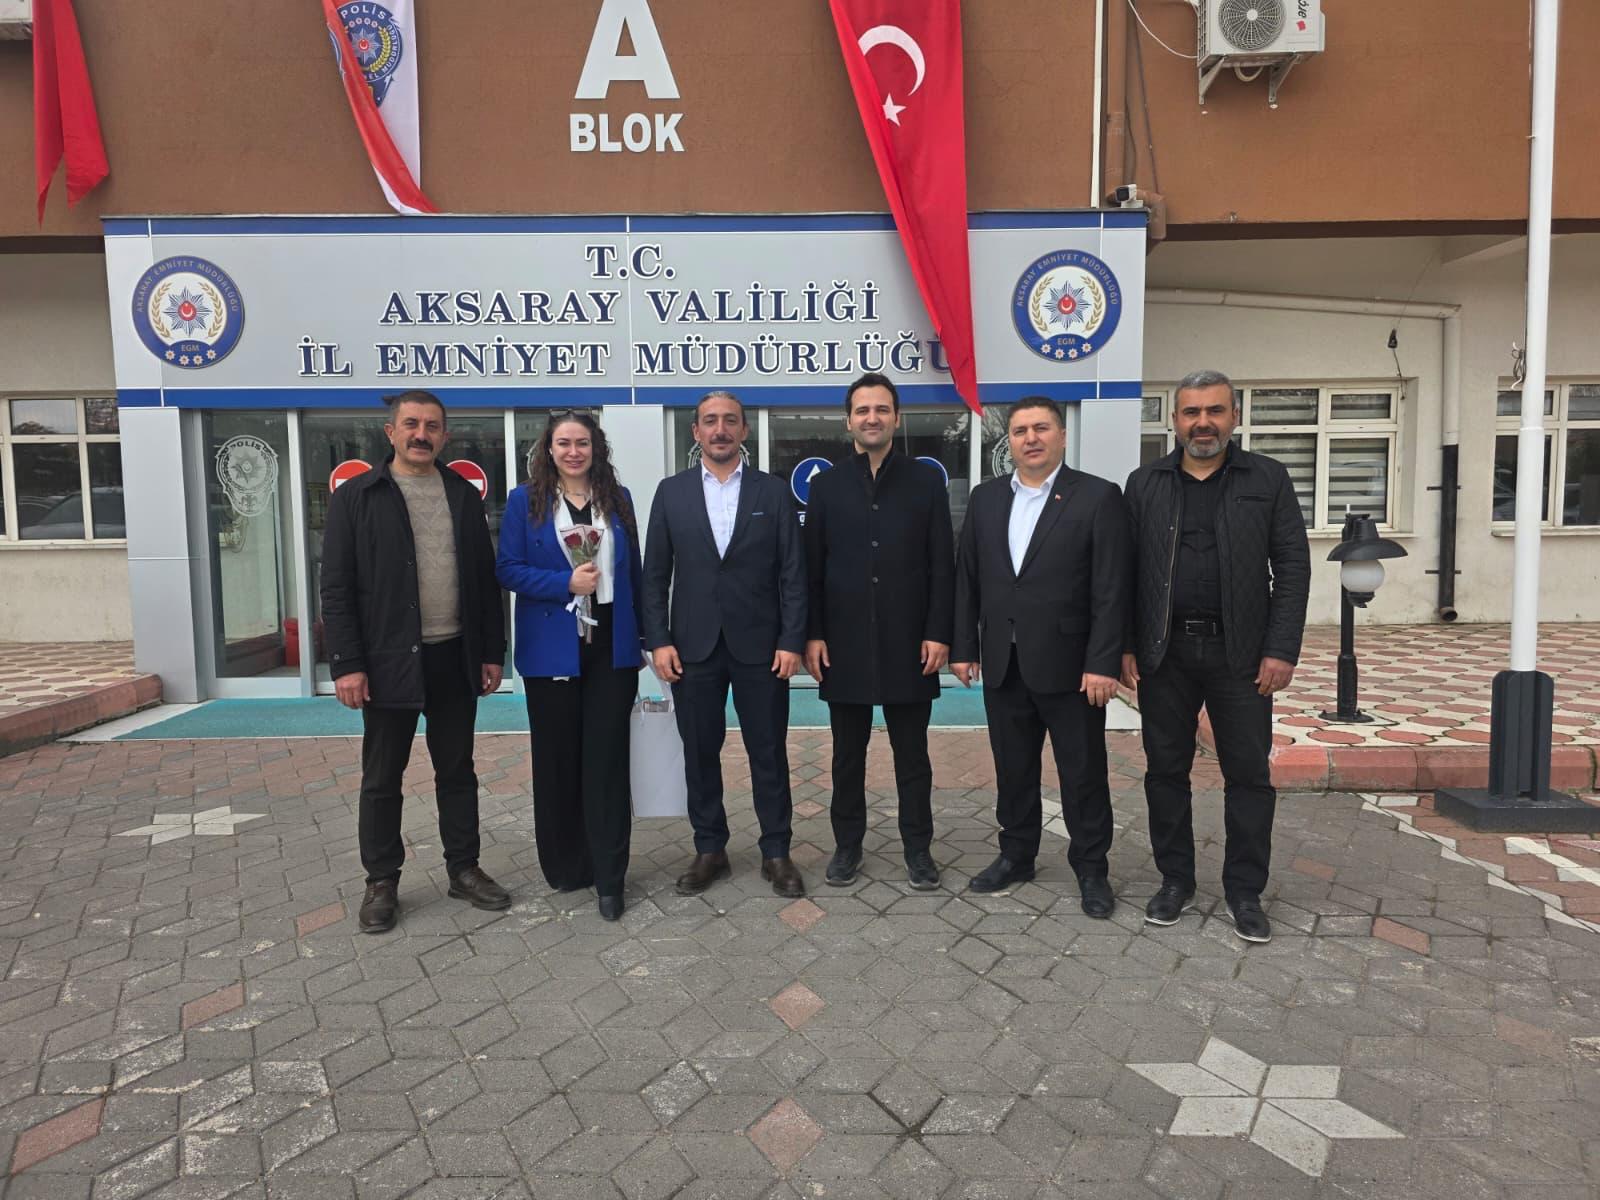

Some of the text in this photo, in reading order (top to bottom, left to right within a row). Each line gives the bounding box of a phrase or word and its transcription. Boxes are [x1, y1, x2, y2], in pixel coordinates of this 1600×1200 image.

[340, 4, 387, 19] POLİS
[574, 0, 681, 99] A
[569, 113, 685, 152] BLOK
[585, 245, 676, 280] T.C.
[1017, 270, 1036, 307] AKSARAY
[1037, 253, 1079, 269] EMNİYET
[378, 280, 880, 326] AKSARAY VALİLİĞİ
[181, 344, 200, 353] EGM
[298, 335, 353, 378] İL
[376, 335, 610, 377] EMNİYET
[1057, 337, 1076, 346] EGM
